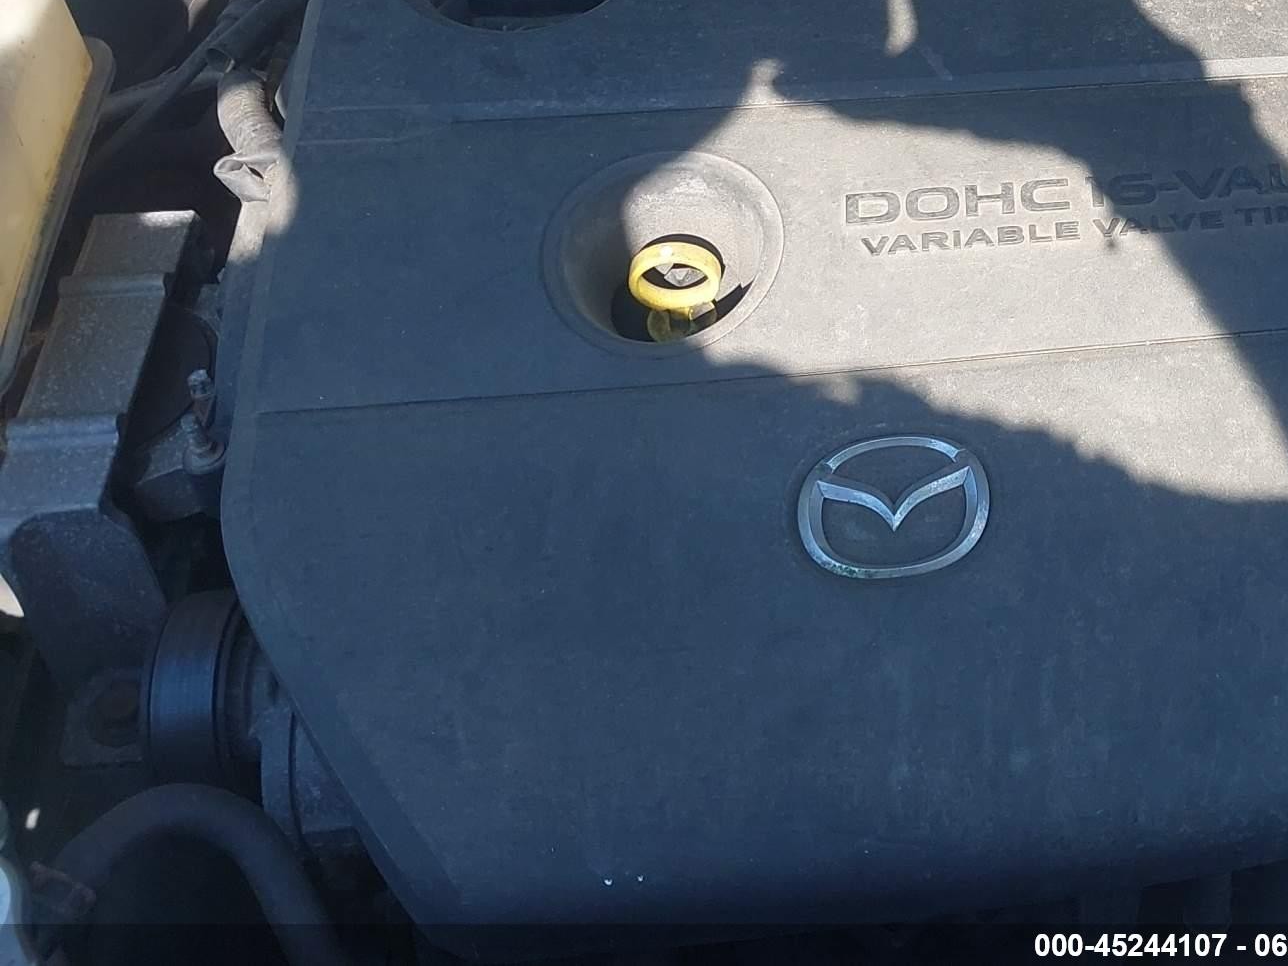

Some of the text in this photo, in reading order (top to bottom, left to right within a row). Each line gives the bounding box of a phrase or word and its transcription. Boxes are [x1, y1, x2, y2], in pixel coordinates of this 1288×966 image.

[844, 177, 1071, 225] DOHC
[861, 219, 1081, 257] VARIABLE
[1093, 209, 1225, 238] VALVE
